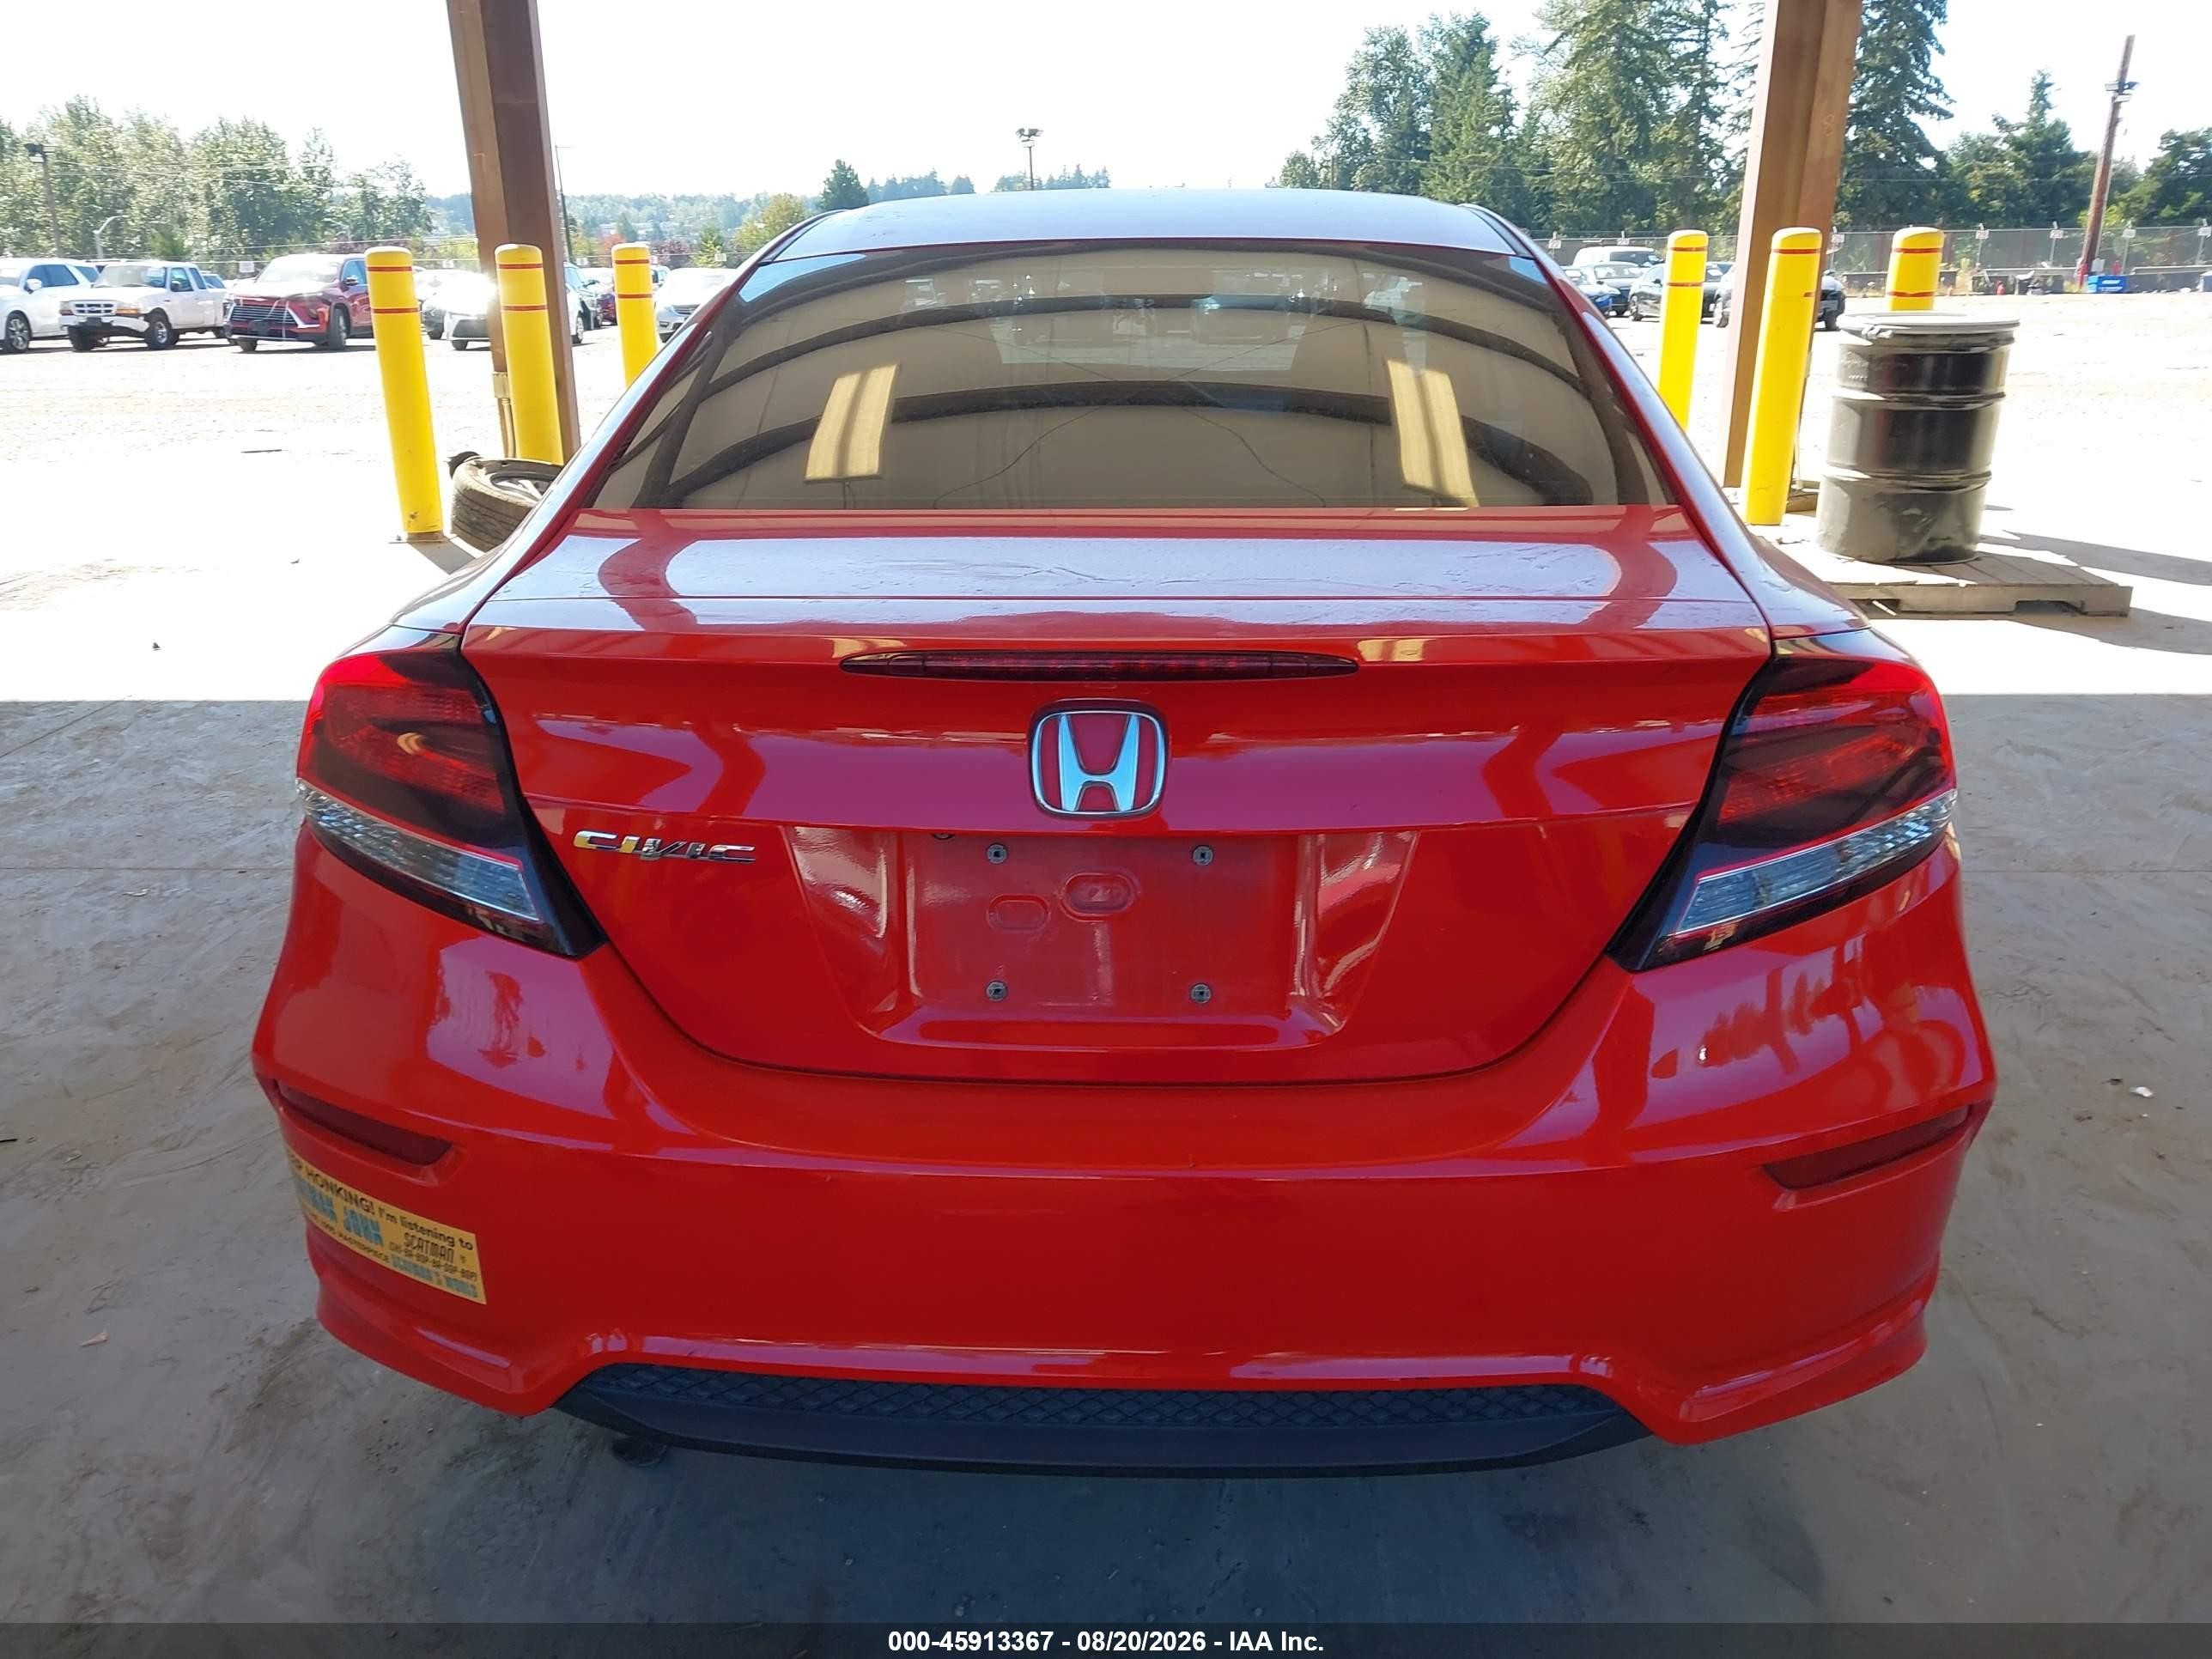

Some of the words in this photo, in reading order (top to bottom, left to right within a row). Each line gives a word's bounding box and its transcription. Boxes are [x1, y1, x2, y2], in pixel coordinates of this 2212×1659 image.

[573, 829, 757, 865] CIVIC
[304, 1166, 375, 1215] HONKING!
[377, 1206, 398, 1224] I'm
[399, 1215, 456, 1248] listening
[458, 1237, 474, 1251] to
